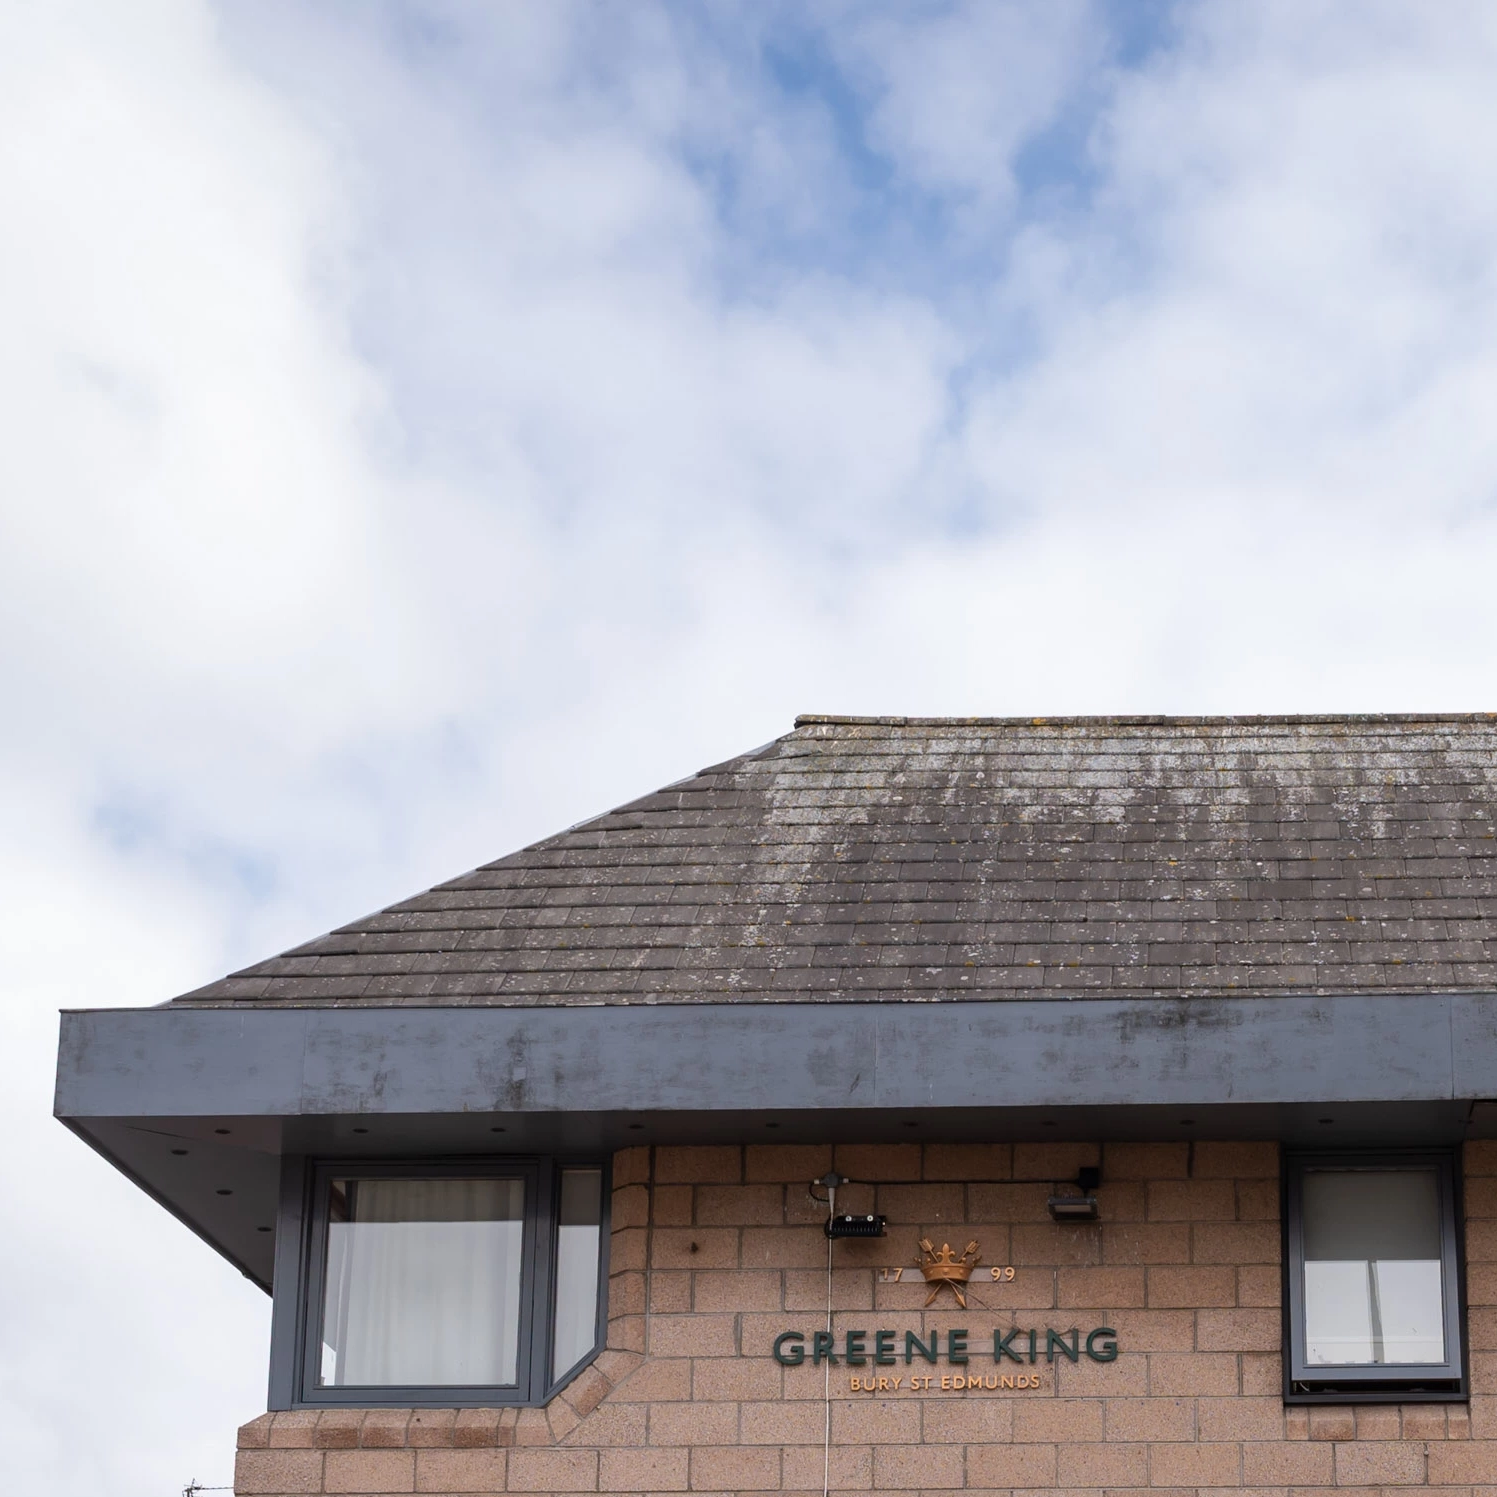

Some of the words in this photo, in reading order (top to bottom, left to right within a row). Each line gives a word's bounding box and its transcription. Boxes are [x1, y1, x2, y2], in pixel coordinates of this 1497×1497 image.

[880, 1267, 903, 1282] 17
[990, 1266, 1016, 1282] 99
[773, 1329, 969, 1366] GREENE
[993, 1327, 1118, 1363] KING
[850, 1377, 902, 1392] BURY
[910, 1376, 932, 1390] ST
[941, 1374, 1040, 1390] EDMUNDS
